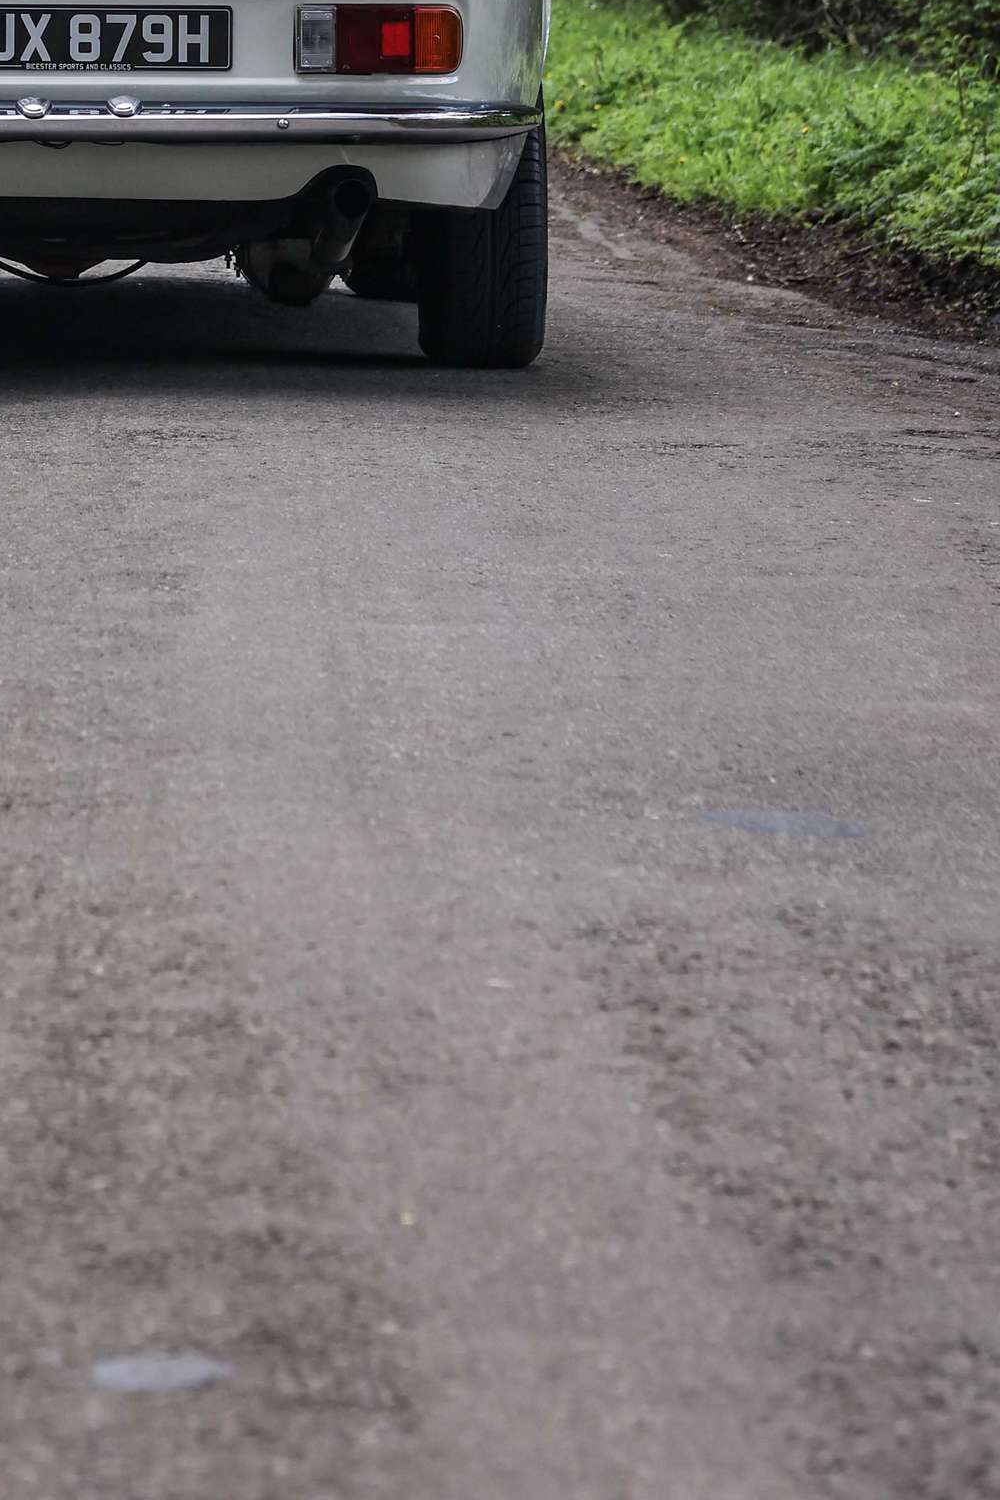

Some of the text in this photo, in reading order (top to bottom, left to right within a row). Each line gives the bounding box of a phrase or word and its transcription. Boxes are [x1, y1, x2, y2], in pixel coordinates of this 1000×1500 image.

[69, 13, 210, 63] 879H
[86, 63, 99, 71] AND
[100, 63, 132, 71] CLASSICS
